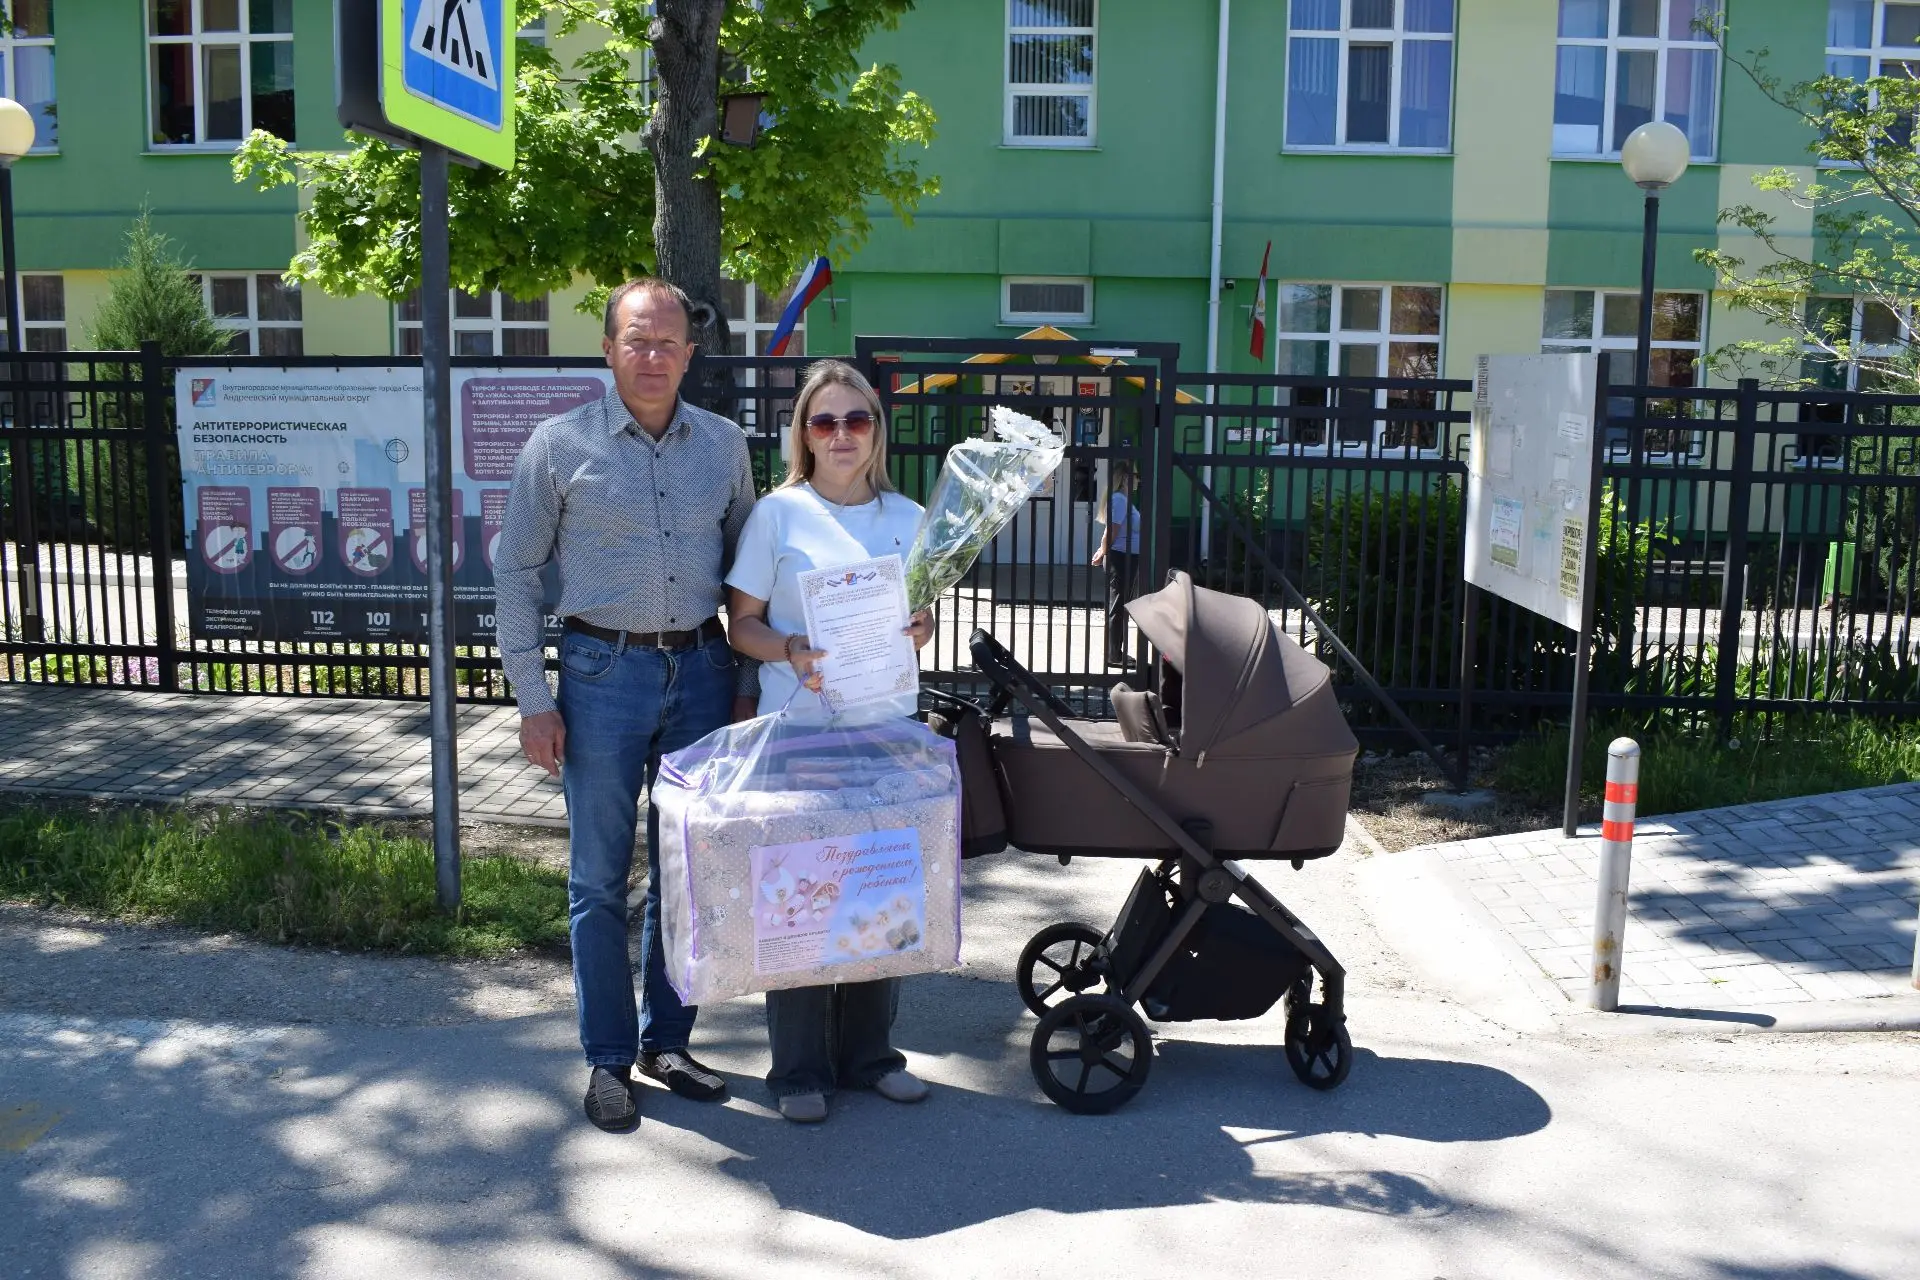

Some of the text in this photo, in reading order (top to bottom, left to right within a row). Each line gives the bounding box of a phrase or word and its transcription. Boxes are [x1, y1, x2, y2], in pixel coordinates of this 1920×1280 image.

[281, 384, 333, 393] муниципальное
[335, 384, 377, 392] образование
[380, 385, 401, 393] города
[403, 384, 423, 392] Севас
[223, 393, 370, 404] Андреевский муниципальный округ
[193, 421, 347, 432] АНТИТЕРРОРИСТИЧЕСКАЯ
[193, 434, 287, 443] БЕЗОПАСНОСТЬ
[194, 449, 270, 462] ПРАВИЛА
[310, 611, 335, 625] 112
[366, 612, 391, 626] 101
[477, 614, 497, 628] 10
[816, 840, 911, 865] Поздравляем
[838, 859, 913, 882] рождением
